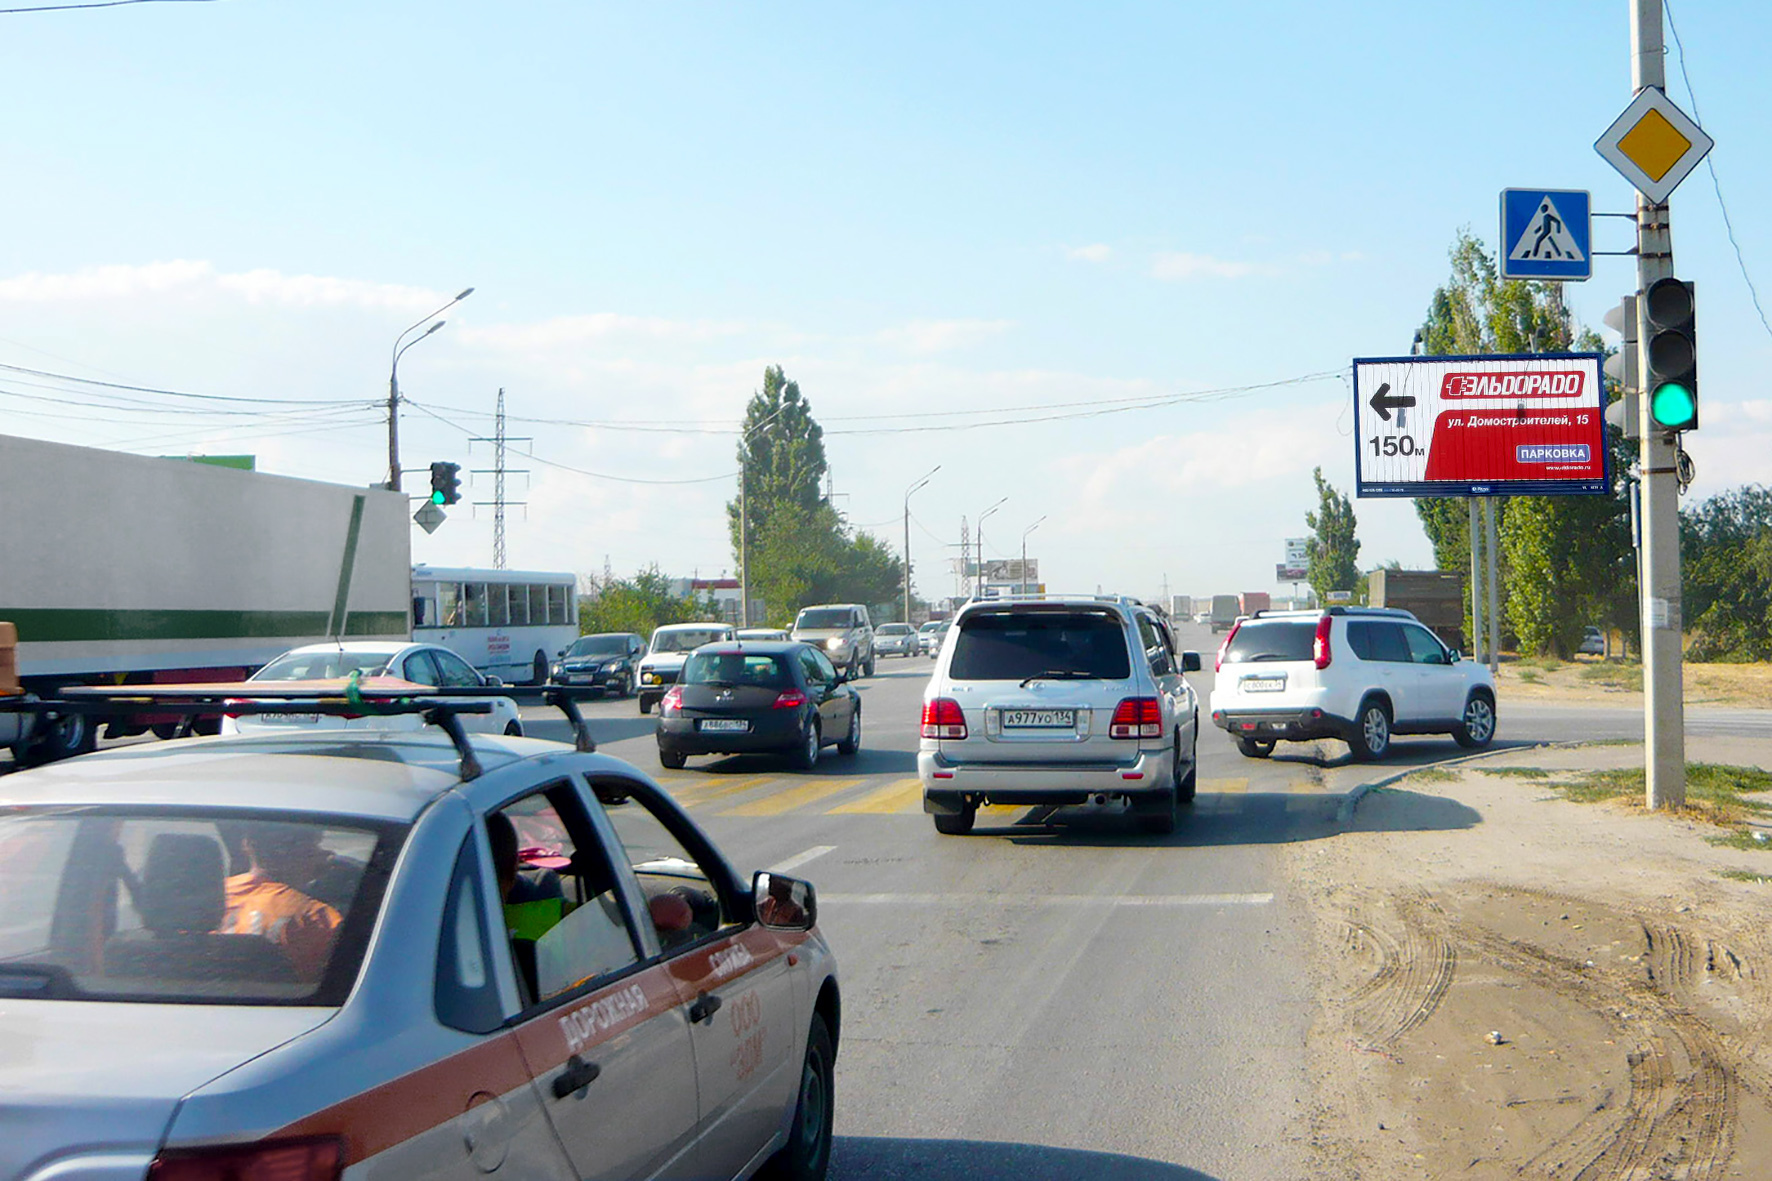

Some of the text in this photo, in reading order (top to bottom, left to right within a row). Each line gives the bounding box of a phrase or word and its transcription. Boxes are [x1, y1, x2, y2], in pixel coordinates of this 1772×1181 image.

[1447, 414, 1589, 428] ул. Домостроителей, 15
[1521, 448, 1586, 459] ПАРКОВКА
[1054, 711, 1071, 722] 134
[558, 984, 650, 1053] ДОРОЖНАЯ
